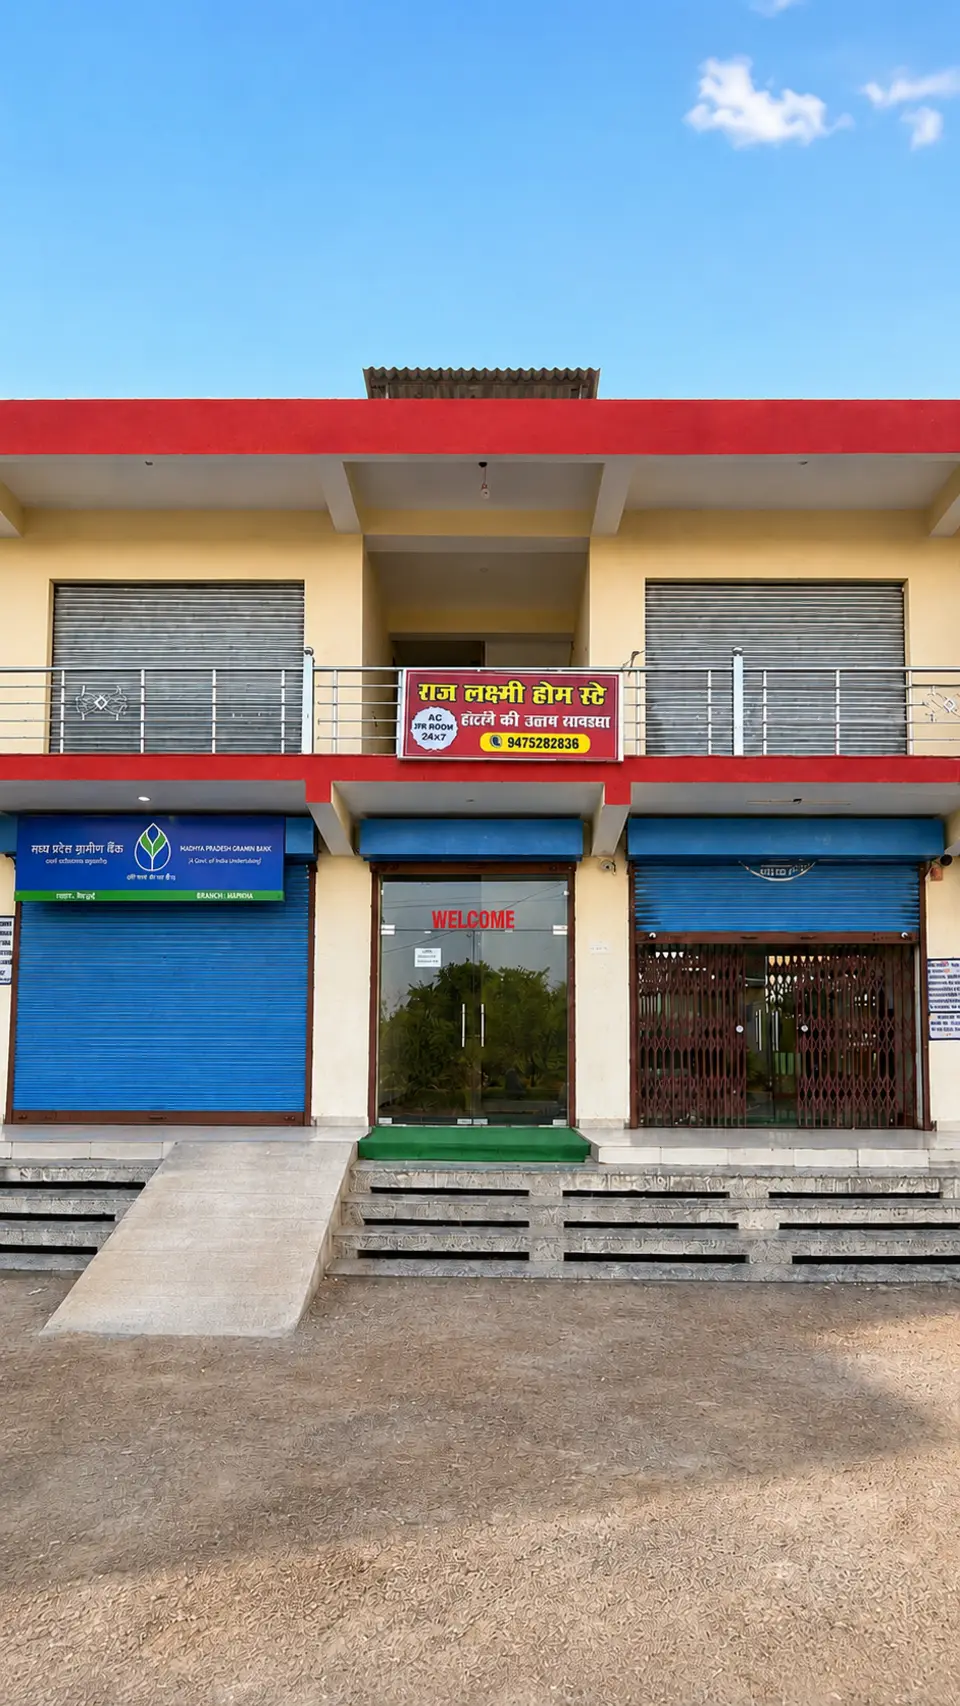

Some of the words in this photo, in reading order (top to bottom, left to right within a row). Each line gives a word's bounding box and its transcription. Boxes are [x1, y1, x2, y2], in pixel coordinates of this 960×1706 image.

[418, 683, 458, 702] राज
[463, 680, 526, 704] लक्ष्मी
[532, 681, 574, 705] होम
[578, 681, 608, 705] स्टे
[428, 713, 442, 721] AC
[499, 711, 520, 727] की
[507, 737, 579, 749] 9475282836
[431, 910, 515, 929] WELCOME
